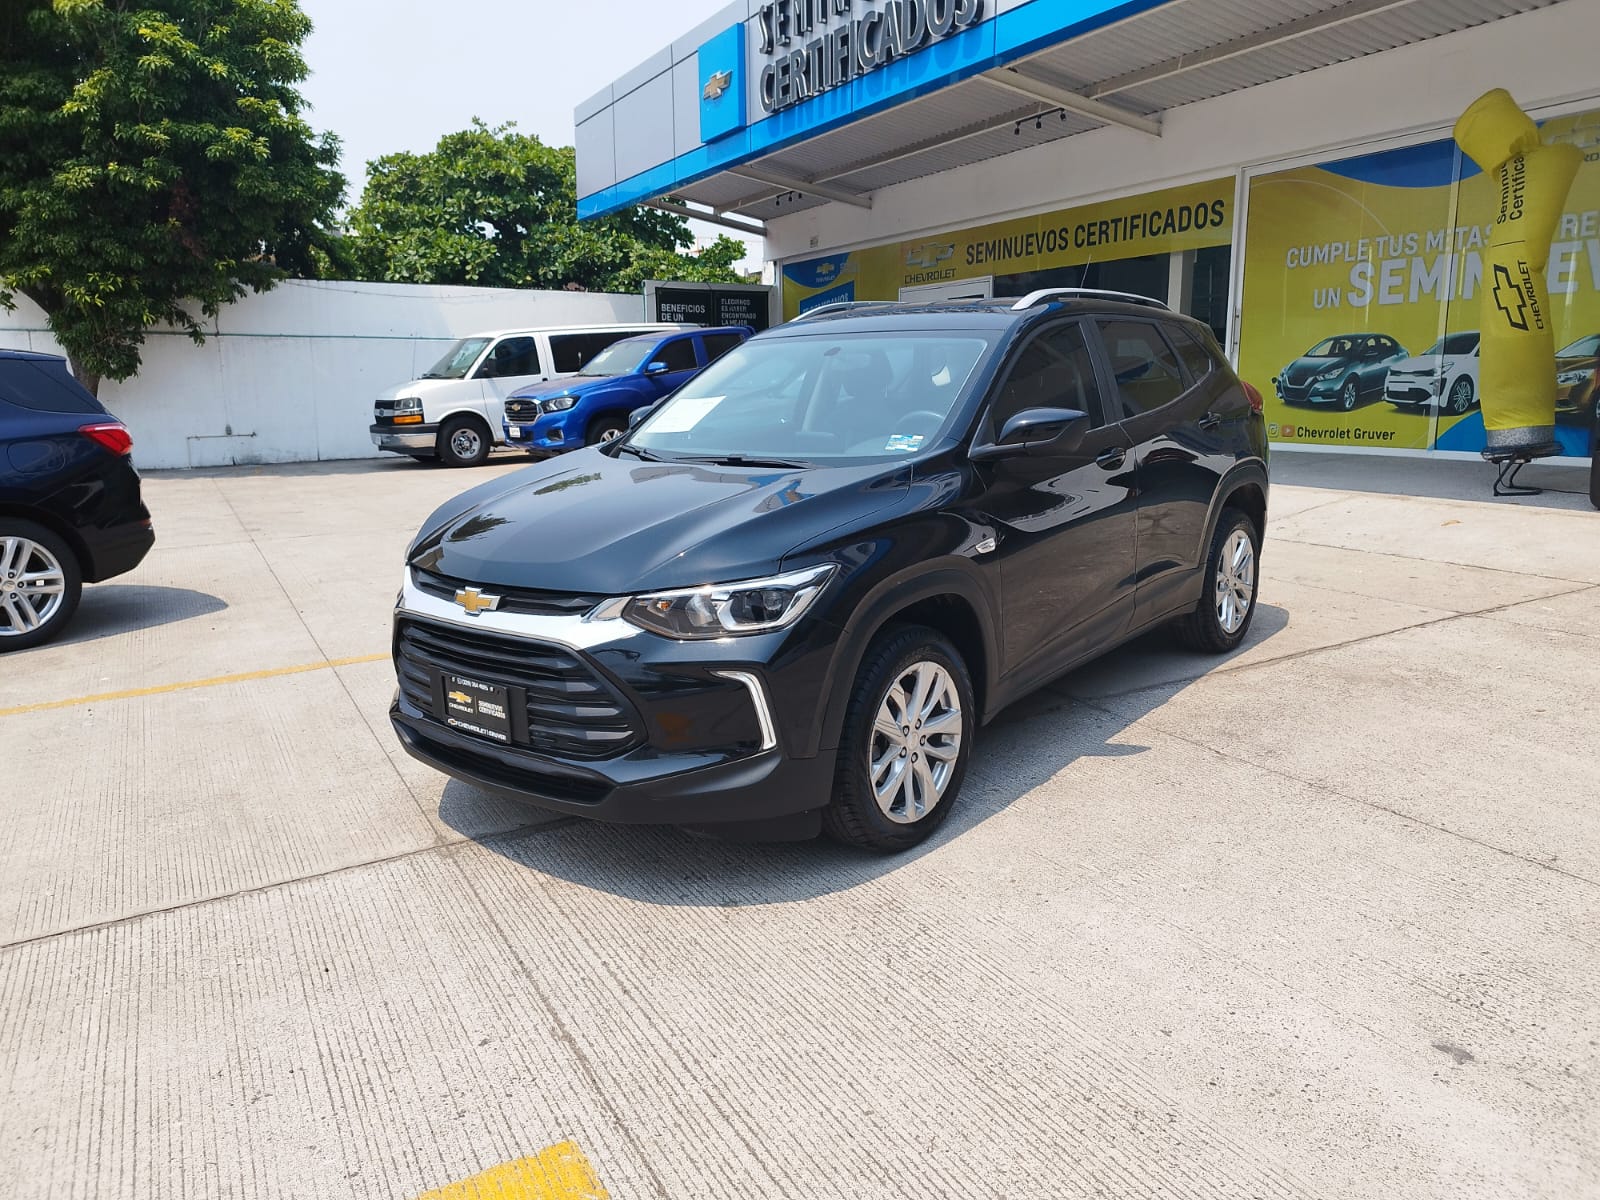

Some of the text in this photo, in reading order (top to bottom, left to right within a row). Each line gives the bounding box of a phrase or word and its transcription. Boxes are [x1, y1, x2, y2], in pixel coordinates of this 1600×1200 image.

[966, 199, 1225, 266] SEMINUEVOS CERTIFICADOS
[1286, 238, 1370, 269] CUMPLE
[1376, 232, 1418, 259] TUS
[1426, 225, 1491, 253] MTA
[905, 268, 957, 285] CHEVROLET
[1313, 287, 1341, 310] UN
[1518, 259, 1544, 330] CHEVROLET
[661, 303, 706, 313] BENEFICIOS
[661, 313, 684, 322] DE UN
[1297, 426, 1396, 440] Chevrolet Gruver
